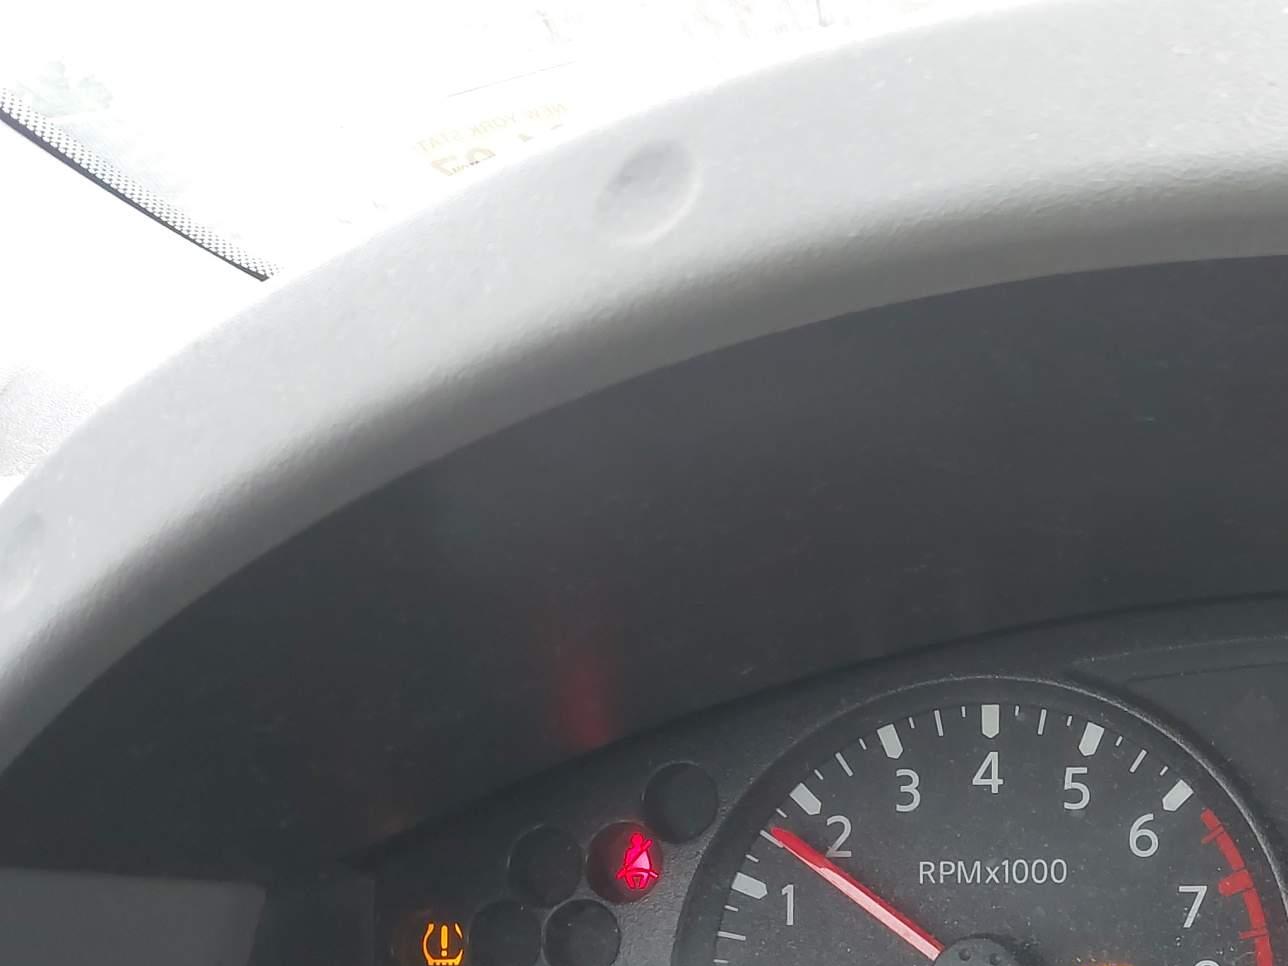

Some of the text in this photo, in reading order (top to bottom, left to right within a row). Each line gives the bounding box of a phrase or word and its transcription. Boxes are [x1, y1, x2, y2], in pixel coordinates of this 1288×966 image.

[895, 768, 921, 812] 3
[972, 751, 1004, 794] 4
[1063, 766, 1090, 810] 5
[826, 815, 852, 858] 2
[1129, 813, 1159, 858] 6
[919, 858, 1067, 884] RPMx1000
[781, 884, 794, 926] 1
[1178, 885, 1208, 928] 7
